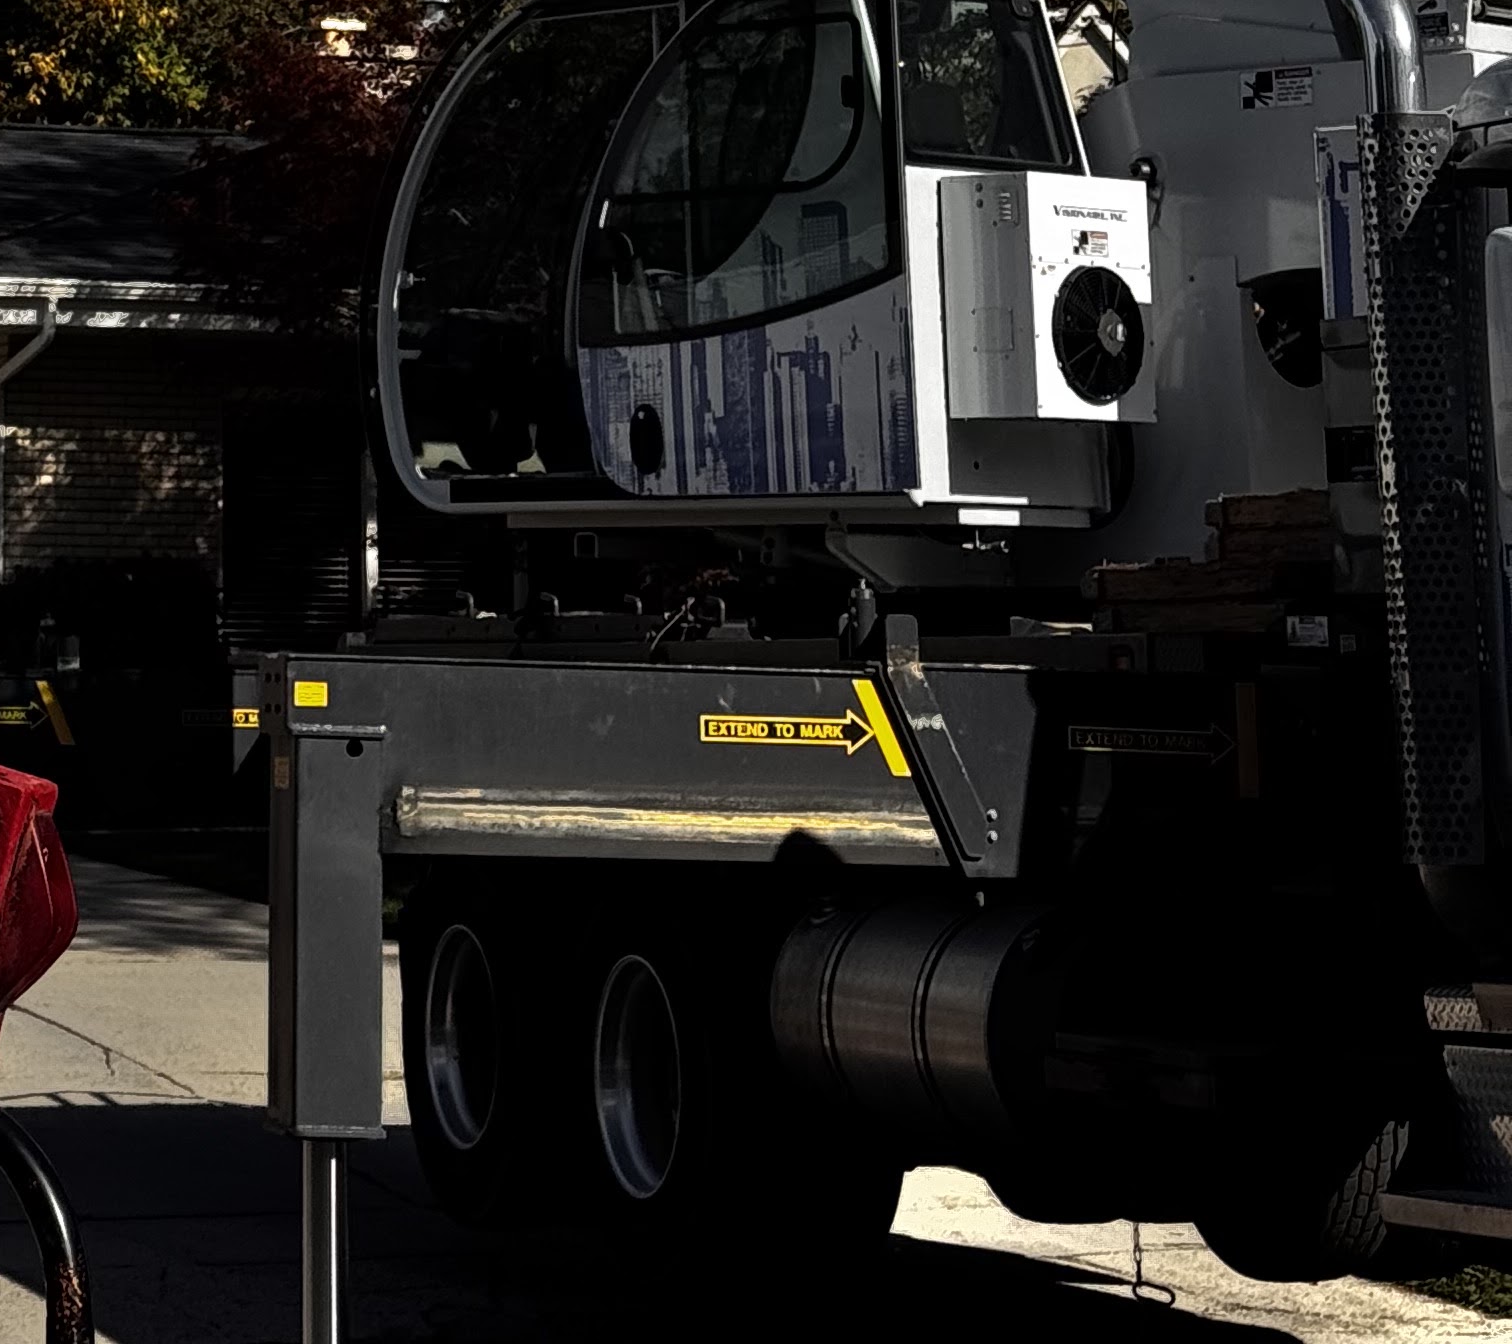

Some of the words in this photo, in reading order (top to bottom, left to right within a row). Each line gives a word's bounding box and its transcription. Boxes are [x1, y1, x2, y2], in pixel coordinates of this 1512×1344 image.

[708, 721, 769, 737] EXTEND
[774, 723, 795, 738] TO
[800, 724, 844, 739] MARK
